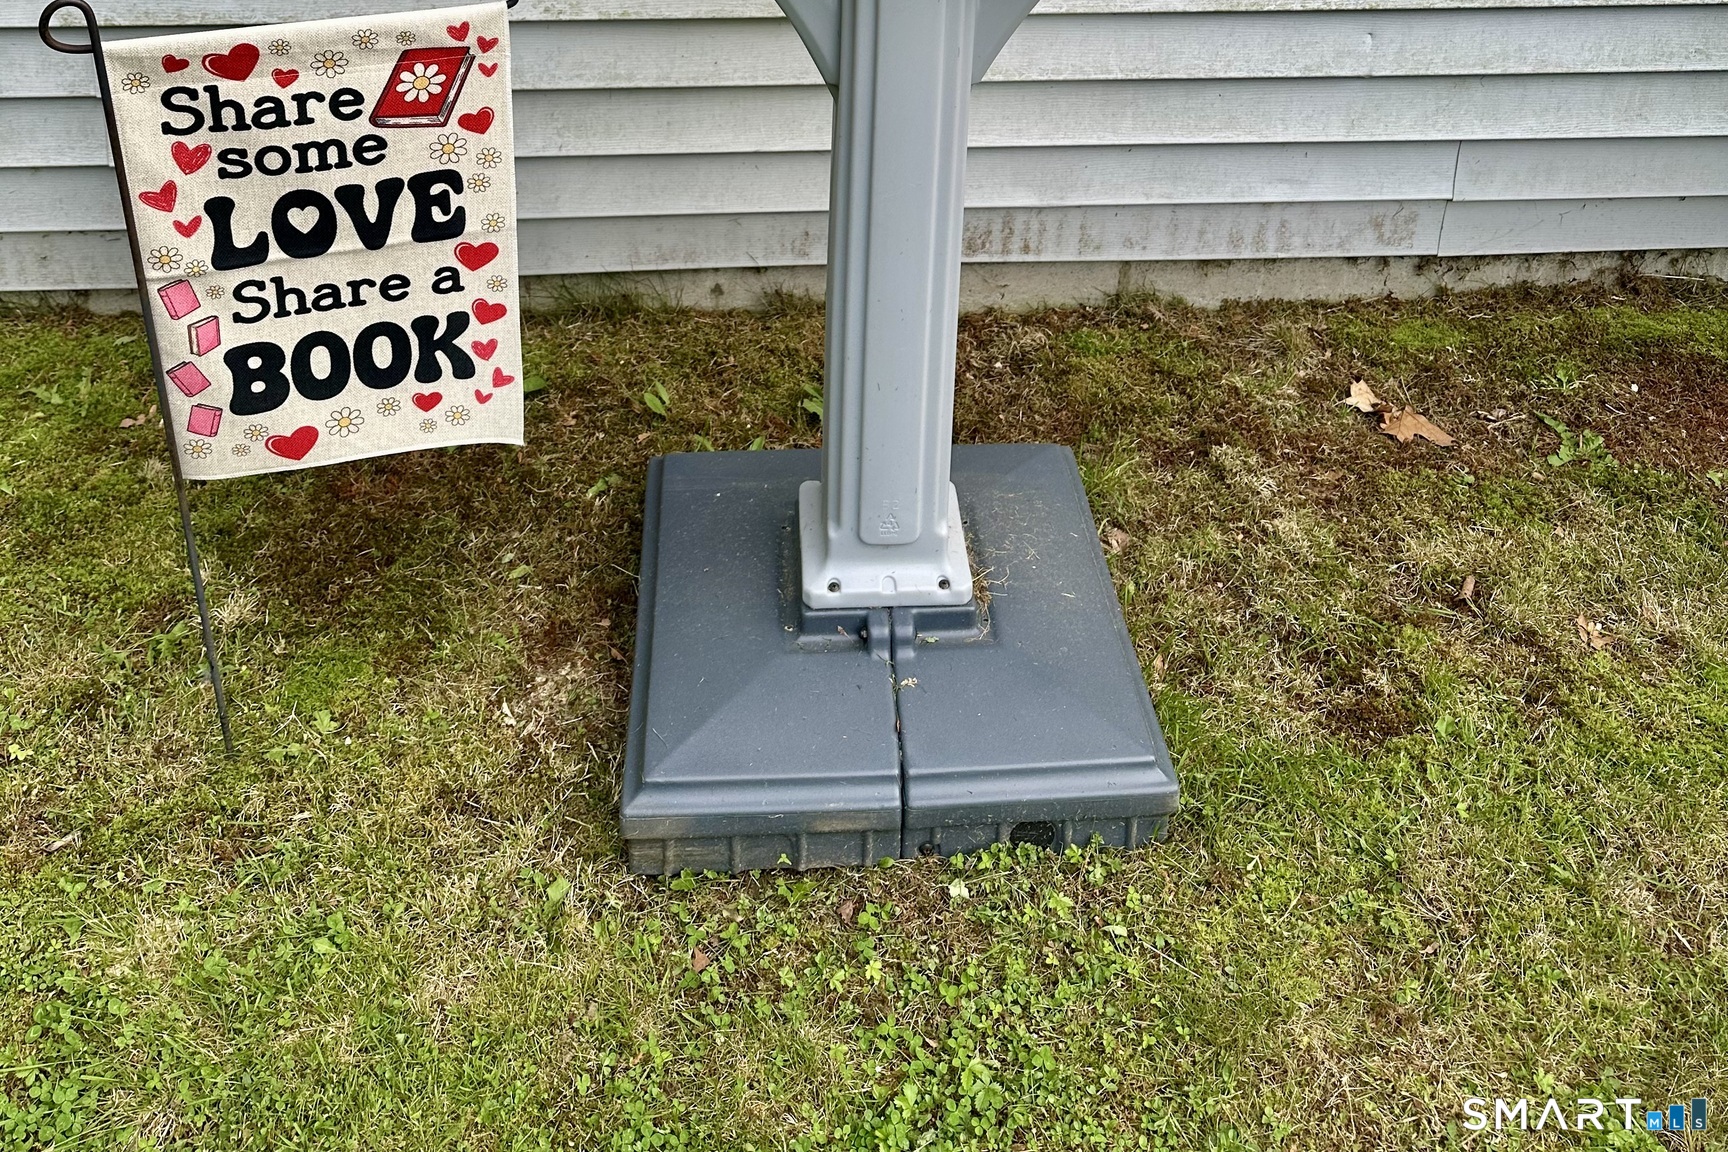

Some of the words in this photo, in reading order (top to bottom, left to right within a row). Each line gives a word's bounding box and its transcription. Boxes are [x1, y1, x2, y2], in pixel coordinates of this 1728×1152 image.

[160, 84, 366, 136] Share
[216, 133, 388, 180] some
[203, 168, 466, 271] LOVE
[231, 272, 411, 324] Share
[431, 266, 465, 295] a
[223, 310, 476, 416] BOOK
